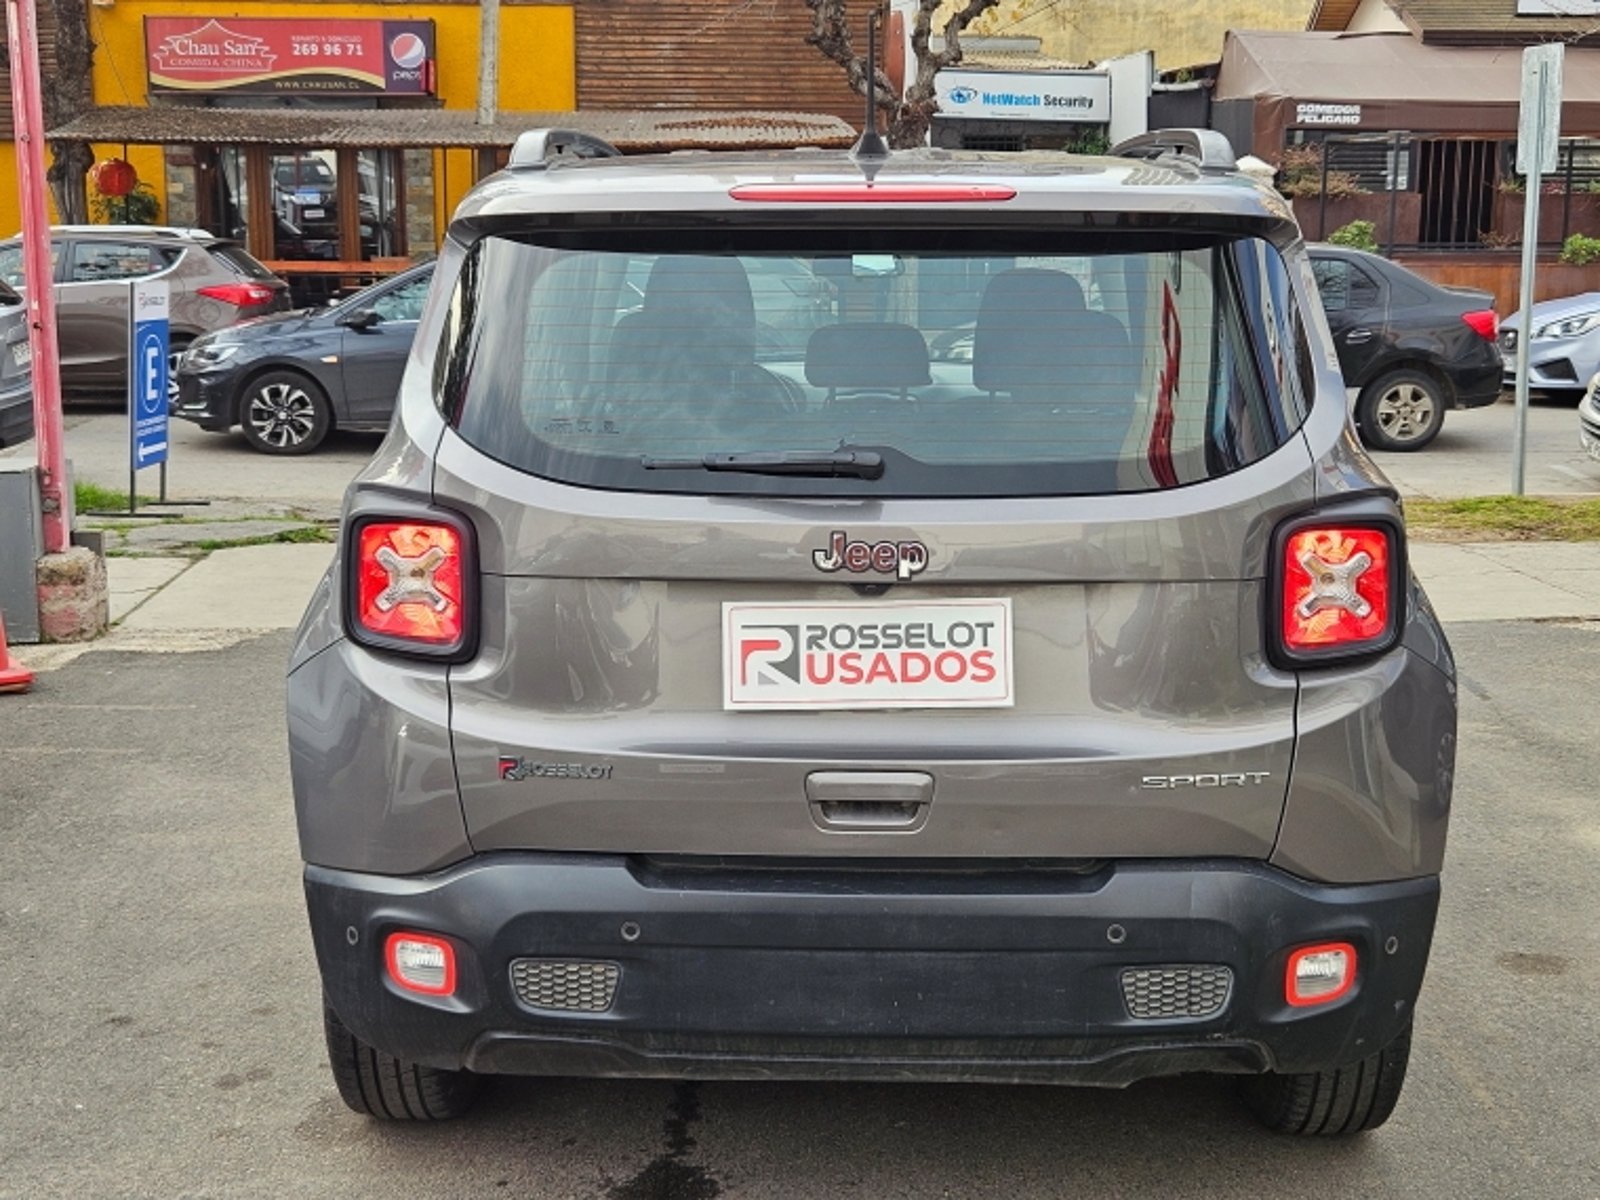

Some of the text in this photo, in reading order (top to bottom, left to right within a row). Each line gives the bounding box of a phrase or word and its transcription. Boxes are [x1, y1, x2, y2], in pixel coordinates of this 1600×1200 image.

[175, 39, 256, 56] Chau San
[292, 43, 363, 56] 269 96 71
[170, 57, 262, 67] COMIDA CHINA
[982, 91, 1094, 109] NetWatch Security
[1296, 104, 1361, 114] COMEDOR
[146, 347, 159, 401] E
[812, 530, 929, 581] Jeep
[805, 621, 996, 651] ROSSELOT
[804, 650, 998, 686] USADOS
[1141, 771, 1271, 790] SPORT
